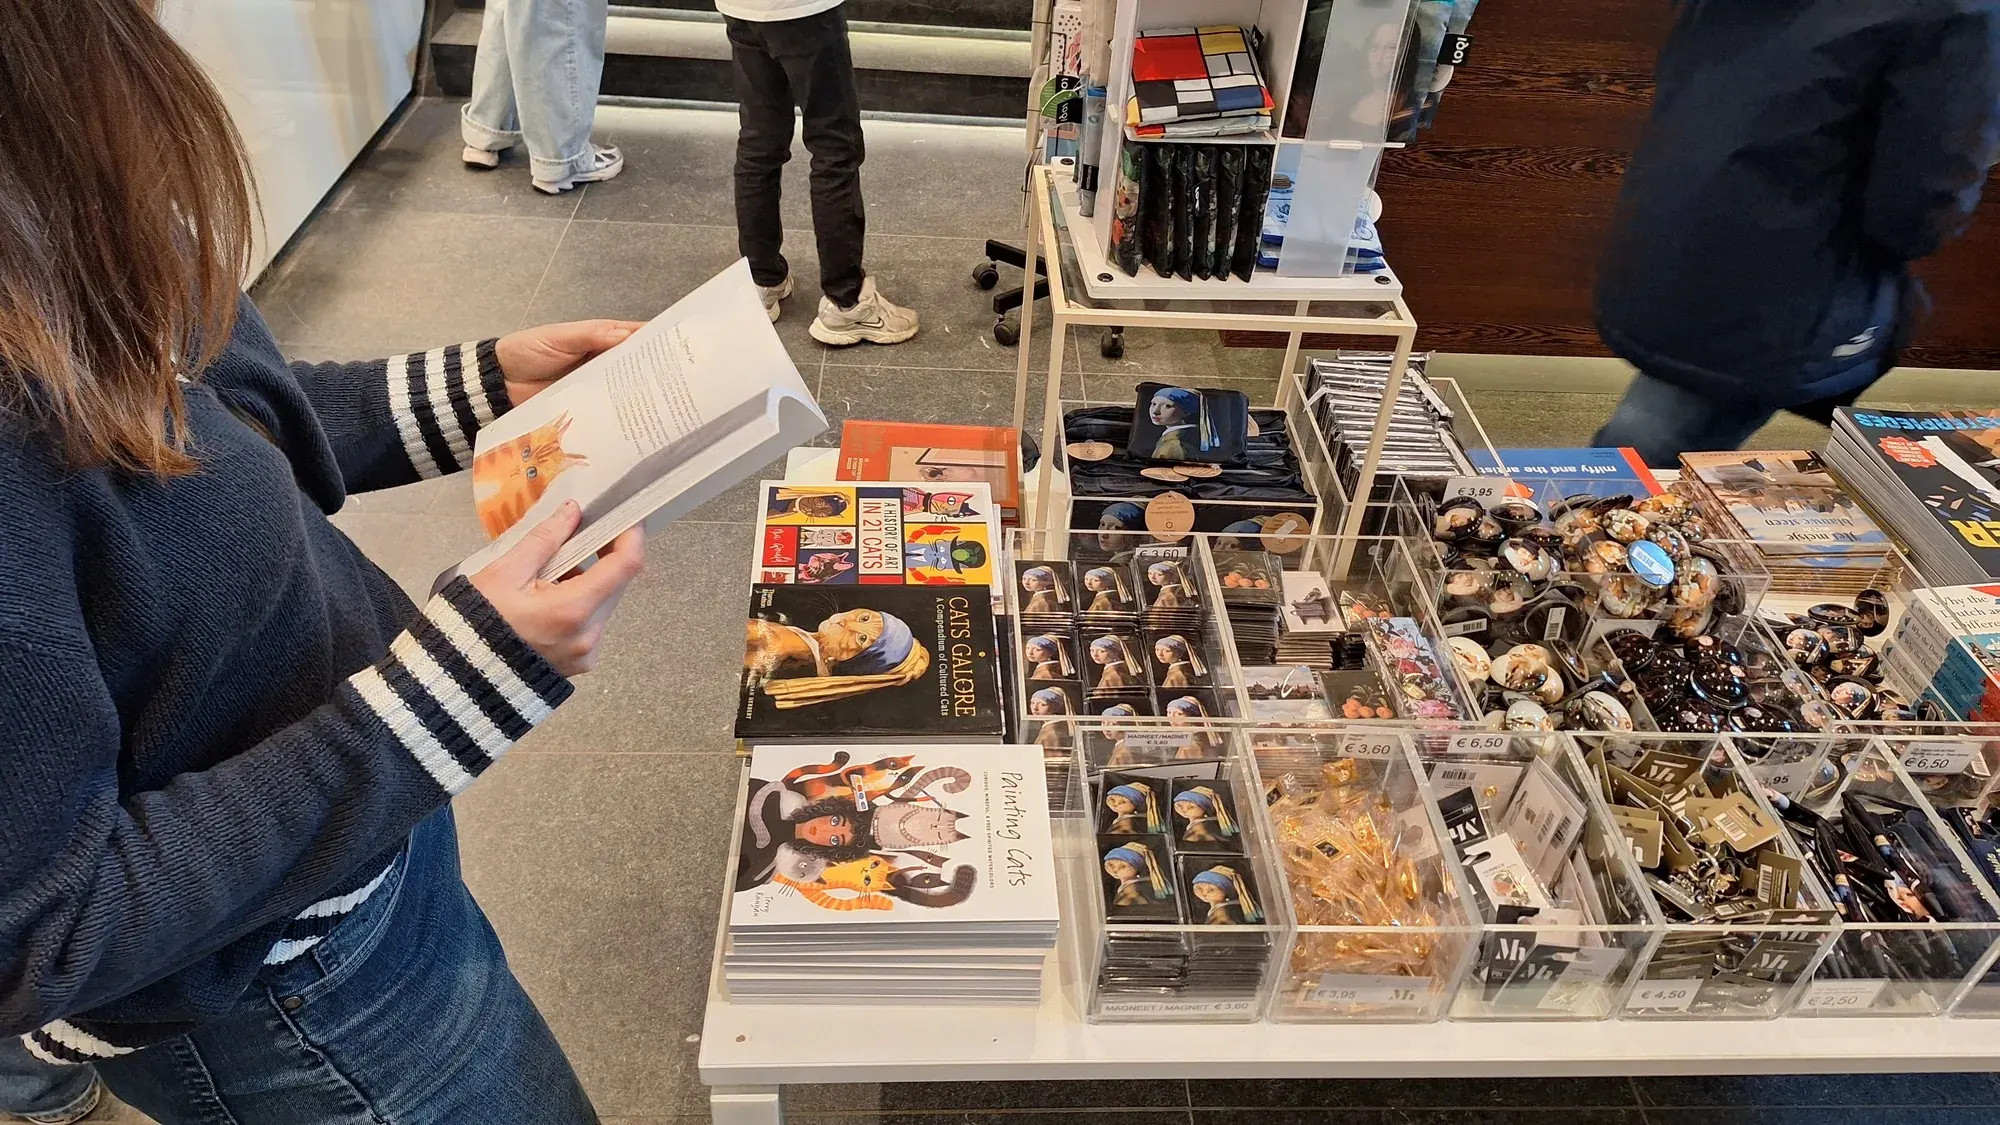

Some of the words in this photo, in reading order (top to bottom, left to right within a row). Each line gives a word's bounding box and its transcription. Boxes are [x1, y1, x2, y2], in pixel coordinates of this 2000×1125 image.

[1524, 466, 1548, 474] the
[1550, 466, 1577, 474] and
[1581, 464, 1617, 474] miffy
[1458, 487, 1466, 496] €
[1468, 488, 1494, 497] 3,95
[862, 502, 877, 515] IN
[862, 519, 879, 534] 21
[884, 509, 898, 543] HISTORY
[1765, 518, 1800, 526] steen
[1805, 518, 1854, 526] blauwe
[1786, 532, 1830, 542] meisje
[890, 543, 897, 551] OF
[862, 538, 883, 570] CATS
[890, 553, 899, 570] ART
[1967, 594, 1989, 603] the
[948, 596, 970, 640] CATS
[934, 604, 945, 651] Compendium
[1935, 627, 1950, 644] Dutch
[1912, 624, 1922, 638] Why
[1922, 637, 1930, 649] the
[1929, 644, 1944, 662] Dutch
[938, 652, 946, 663] of
[1904, 638, 1915, 653] Why
[1914, 651, 1922, 662] the
[1921, 659, 1936, 677] Dutch
[938, 664, 948, 699] Cultured
[952, 643, 976, 718] GALORE
[940, 700, 949, 716] Cats
[1344, 743, 1355, 753] €
[1358, 744, 1391, 755] 3,60
[1456, 738, 1467, 748] €
[1470, 738, 1504, 749] 6,50
[1904, 758, 1916, 767] €
[1918, 758, 1950, 770] 6,50
[996, 771, 1027, 840] Painting
[1006, 848, 1033, 888] Cats
[1329, 990, 1357, 999] 3,95
[1641, 991, 1651, 999] €
[1654, 990, 1687, 1000] 4,50
[1224, 1002, 1249, 1010] 3,60
[1808, 996, 1821, 1006] €
[1822, 996, 1858, 1006] 2,50
